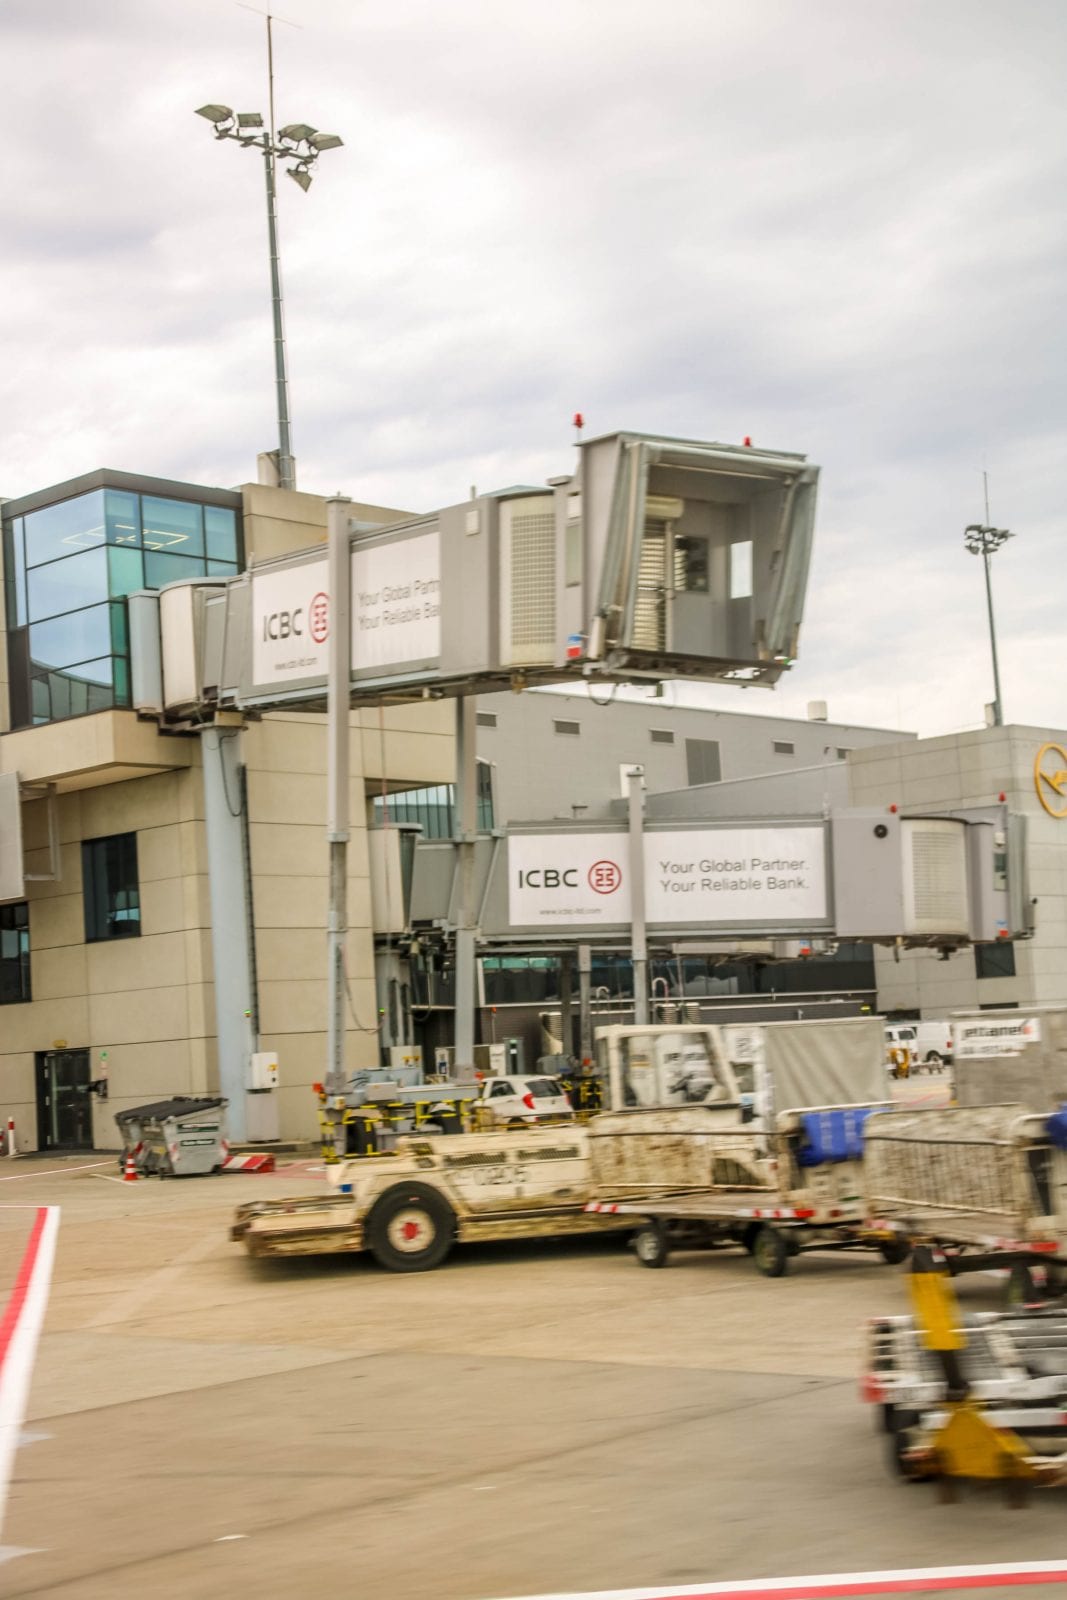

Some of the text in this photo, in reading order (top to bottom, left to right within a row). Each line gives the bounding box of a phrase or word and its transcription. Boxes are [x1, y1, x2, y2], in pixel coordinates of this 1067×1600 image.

[358, 592, 380, 607] Your
[382, 584, 411, 602] Global
[263, 608, 302, 642] ICBC
[358, 615, 381, 631] Your
[382, 606, 421, 626] Reliable
[659, 858, 810, 874] Your Global Partner.
[518, 868, 578, 889] ICBC
[660, 876, 810, 893] Your Reliable Bank.
